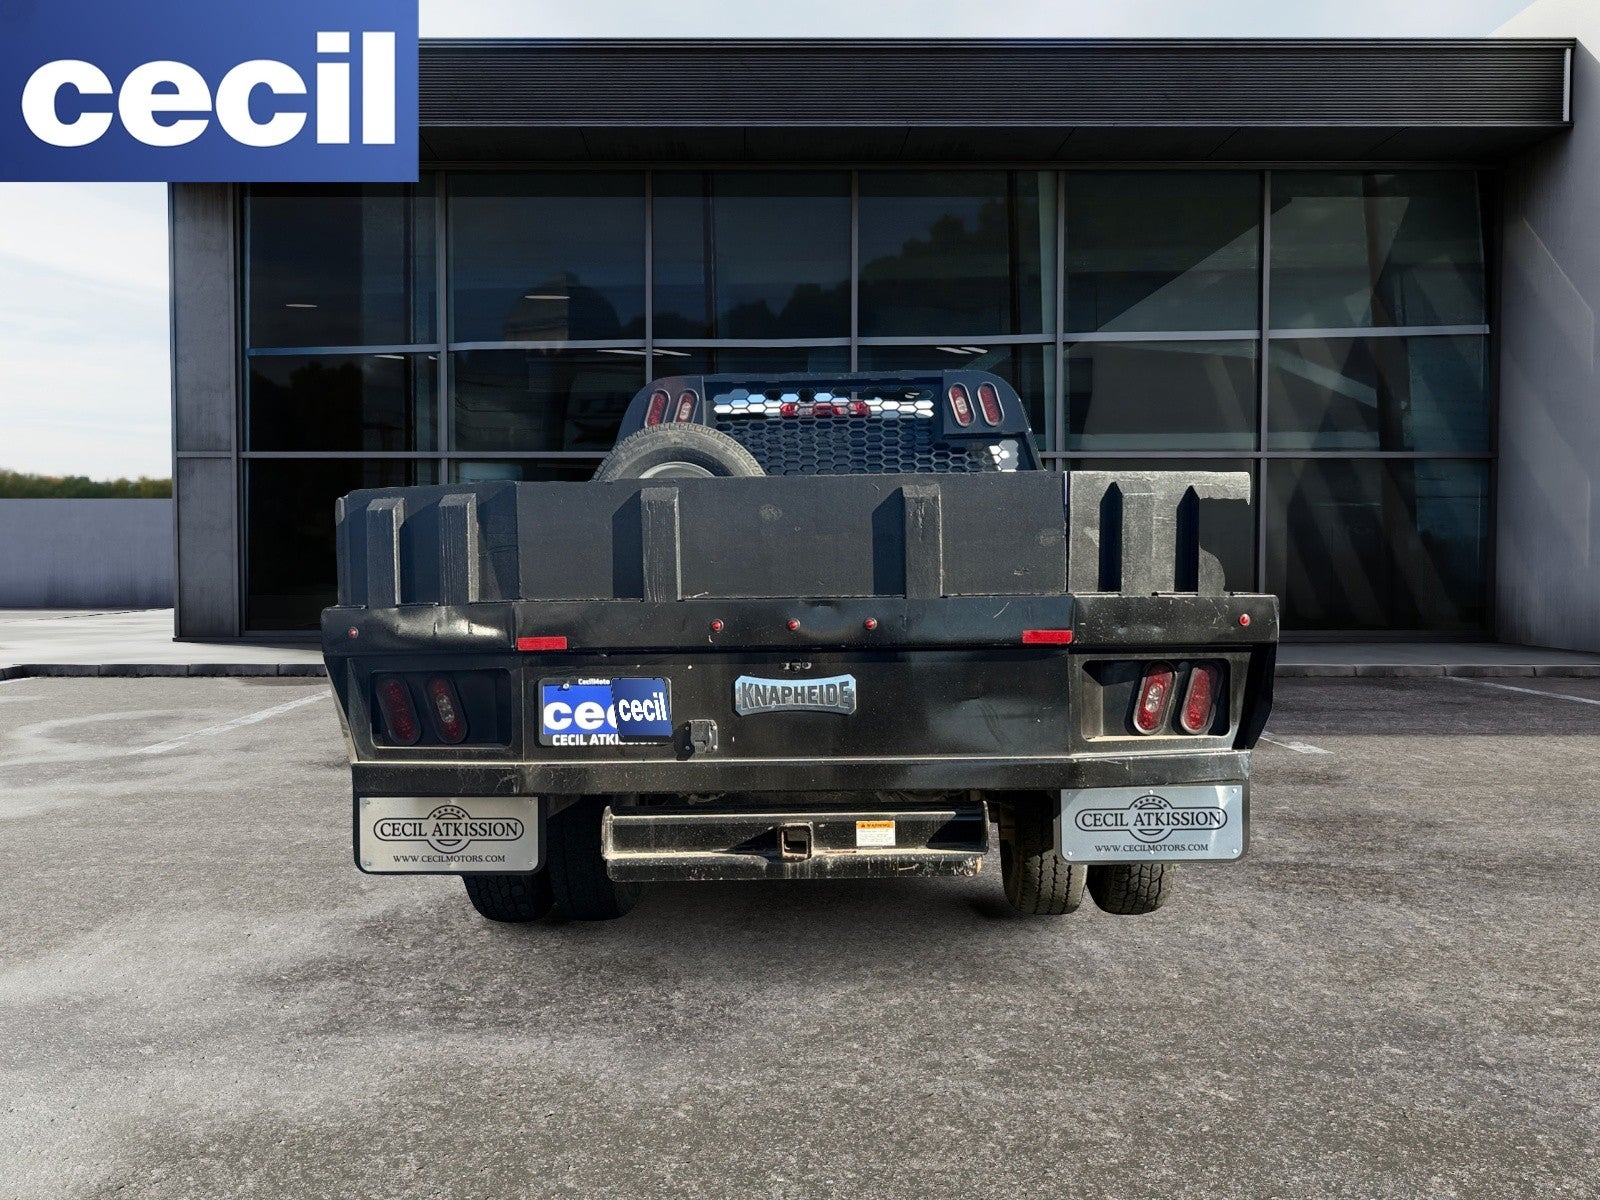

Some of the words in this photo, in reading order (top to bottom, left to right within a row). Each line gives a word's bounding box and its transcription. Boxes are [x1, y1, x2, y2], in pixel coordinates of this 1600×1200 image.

[741, 680, 851, 709] KNAPHEIDE
[552, 733, 588, 746] CECIL
[1081, 812, 1128, 827] CECIL
[1133, 811, 1222, 826] ATKISSION
[380, 822, 427, 837] CECIL
[432, 822, 518, 837] ATKISSION
